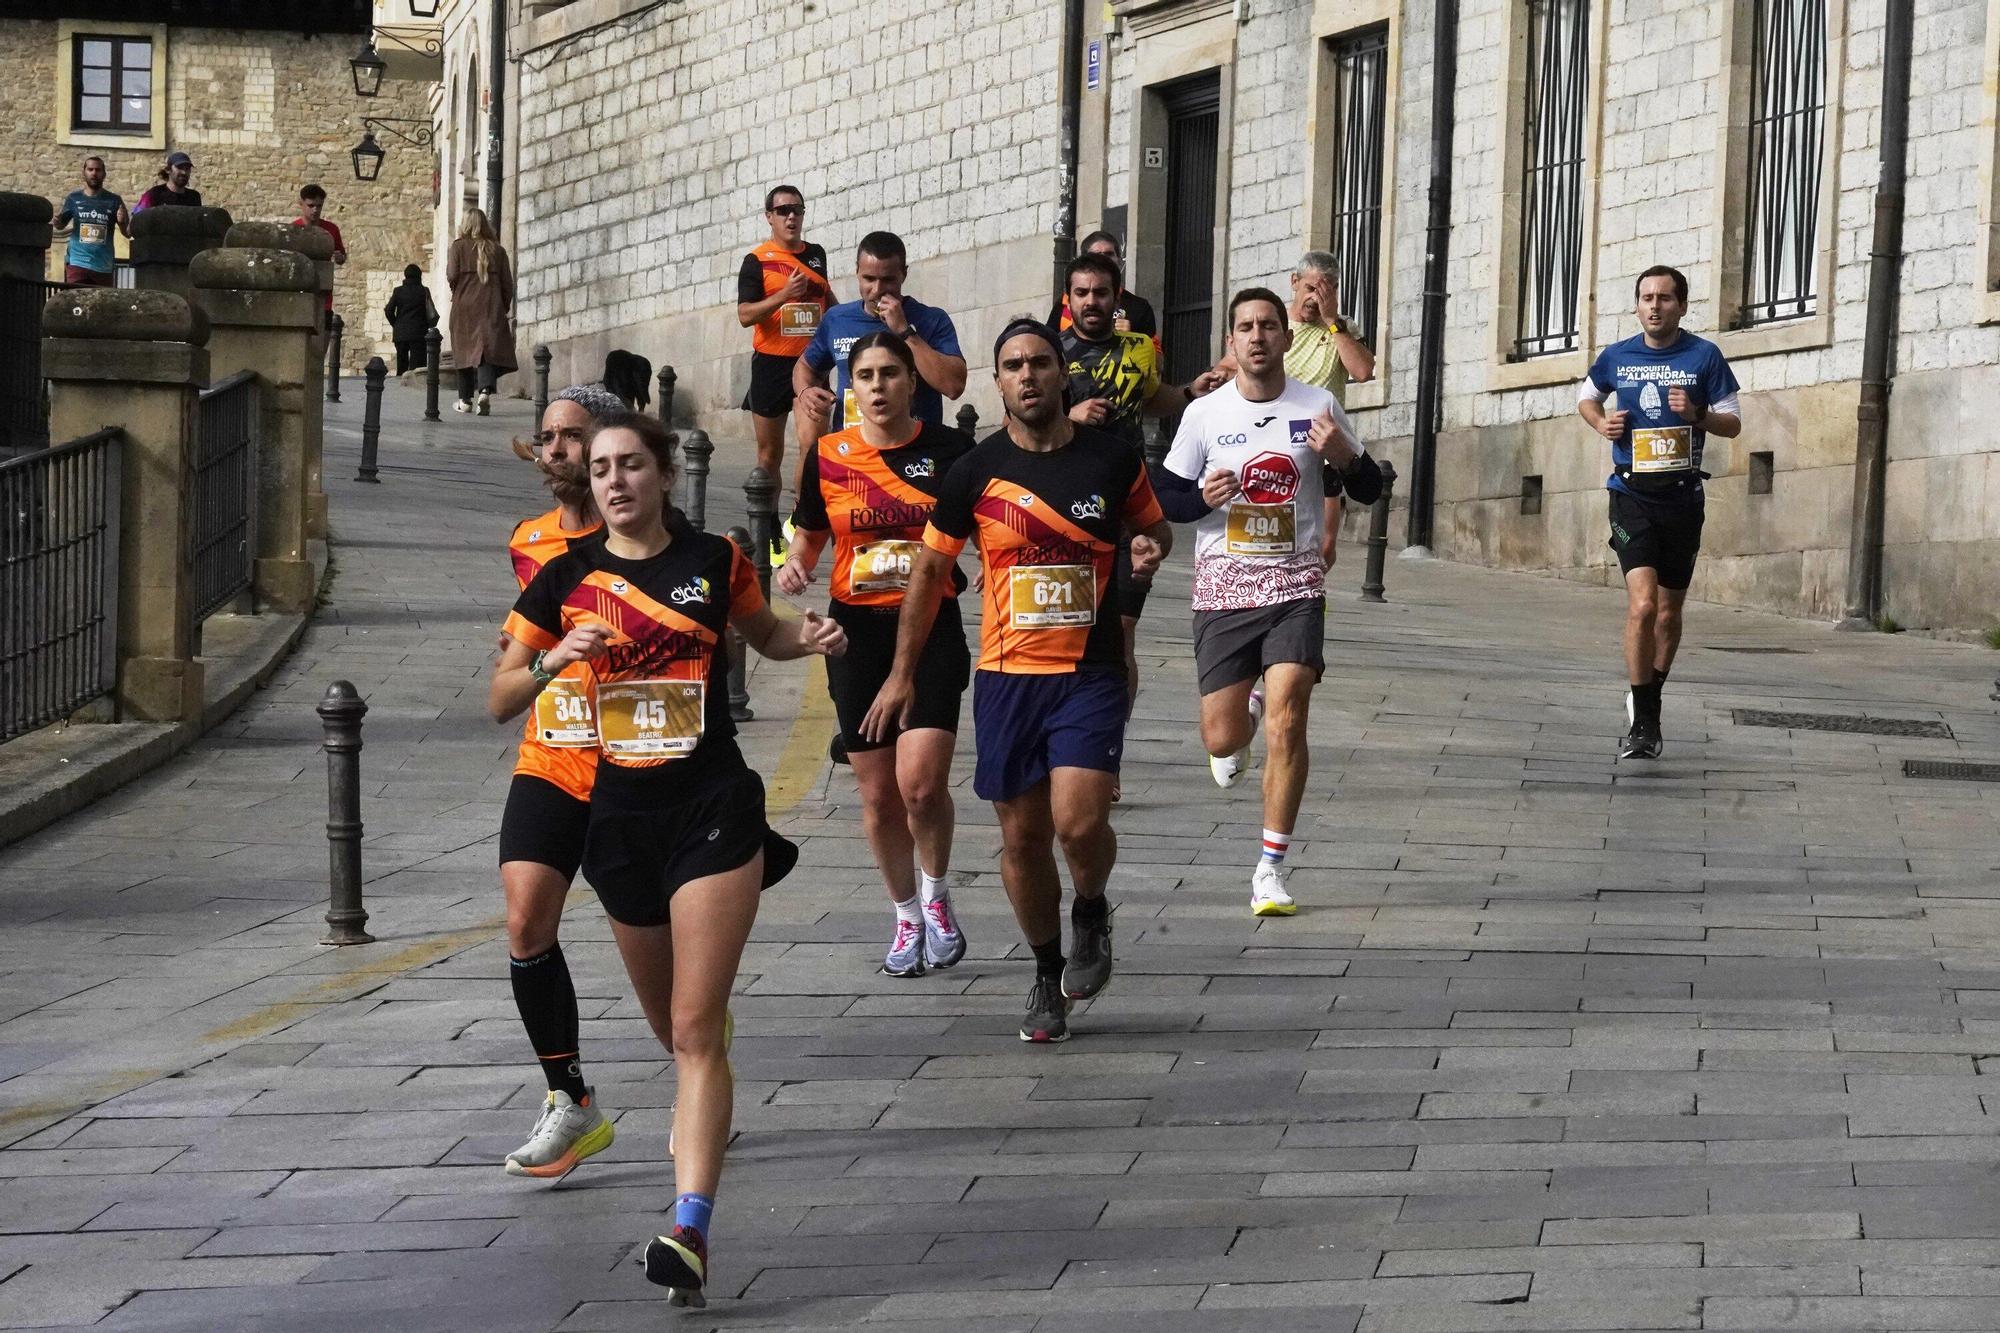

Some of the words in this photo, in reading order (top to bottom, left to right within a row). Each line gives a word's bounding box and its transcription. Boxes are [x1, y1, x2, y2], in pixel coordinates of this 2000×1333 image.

[1626, 365, 1670, 373] CONQUISTA
[1627, 370, 1686, 381] ALMENDRA
[1291, 431, 1309, 442] AXA
[1648, 438, 1676, 456] 162
[1250, 467, 1293, 485] PONLE
[1247, 480, 1289, 496] FRENO
[1244, 516, 1280, 537] 494
[872, 554, 911, 575] 646
[1034, 581, 1073, 606] 621
[682, 687, 697, 696] 10K
[554, 696, 593, 722] 347
[633, 700, 667, 730] 45
[638, 730, 663, 740] BEATRIZ
